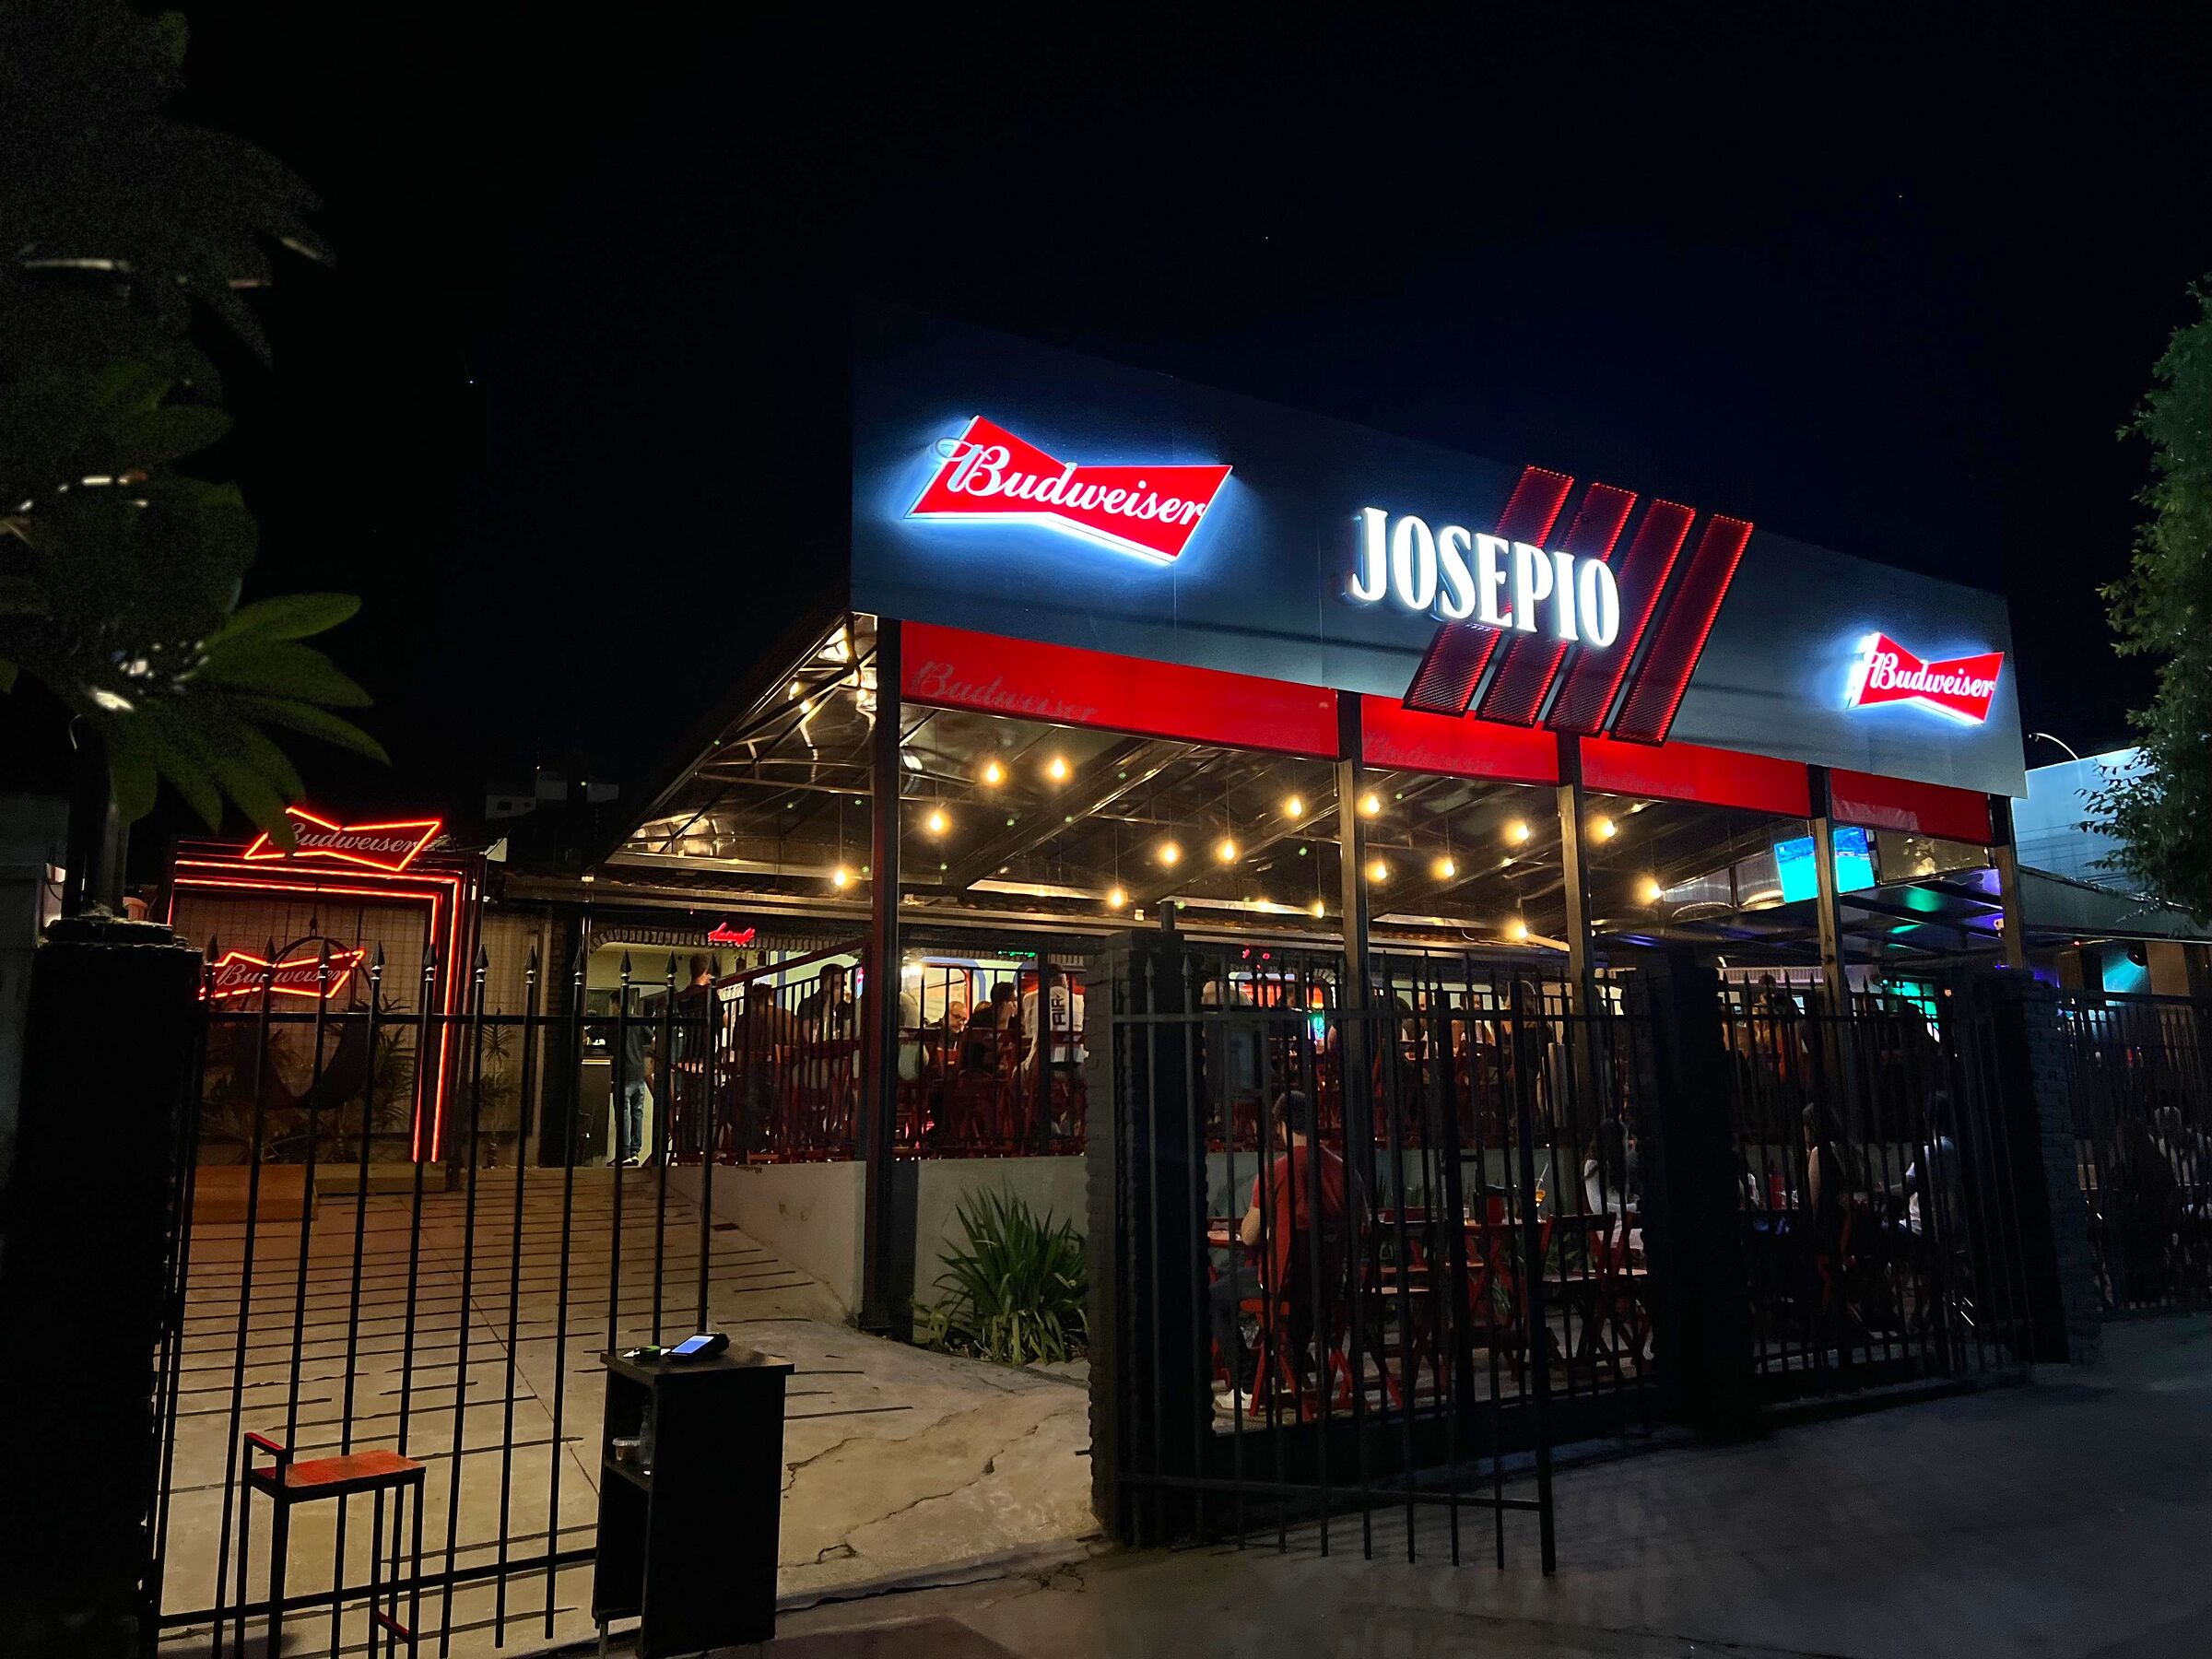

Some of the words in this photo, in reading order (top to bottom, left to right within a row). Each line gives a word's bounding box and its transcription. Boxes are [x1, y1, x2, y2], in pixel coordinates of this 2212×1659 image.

[935, 437, 1206, 525] Budweiser
[1351, 506, 1620, 647] JOSEPIO
[1862, 650, 1996, 699] Budweiser
